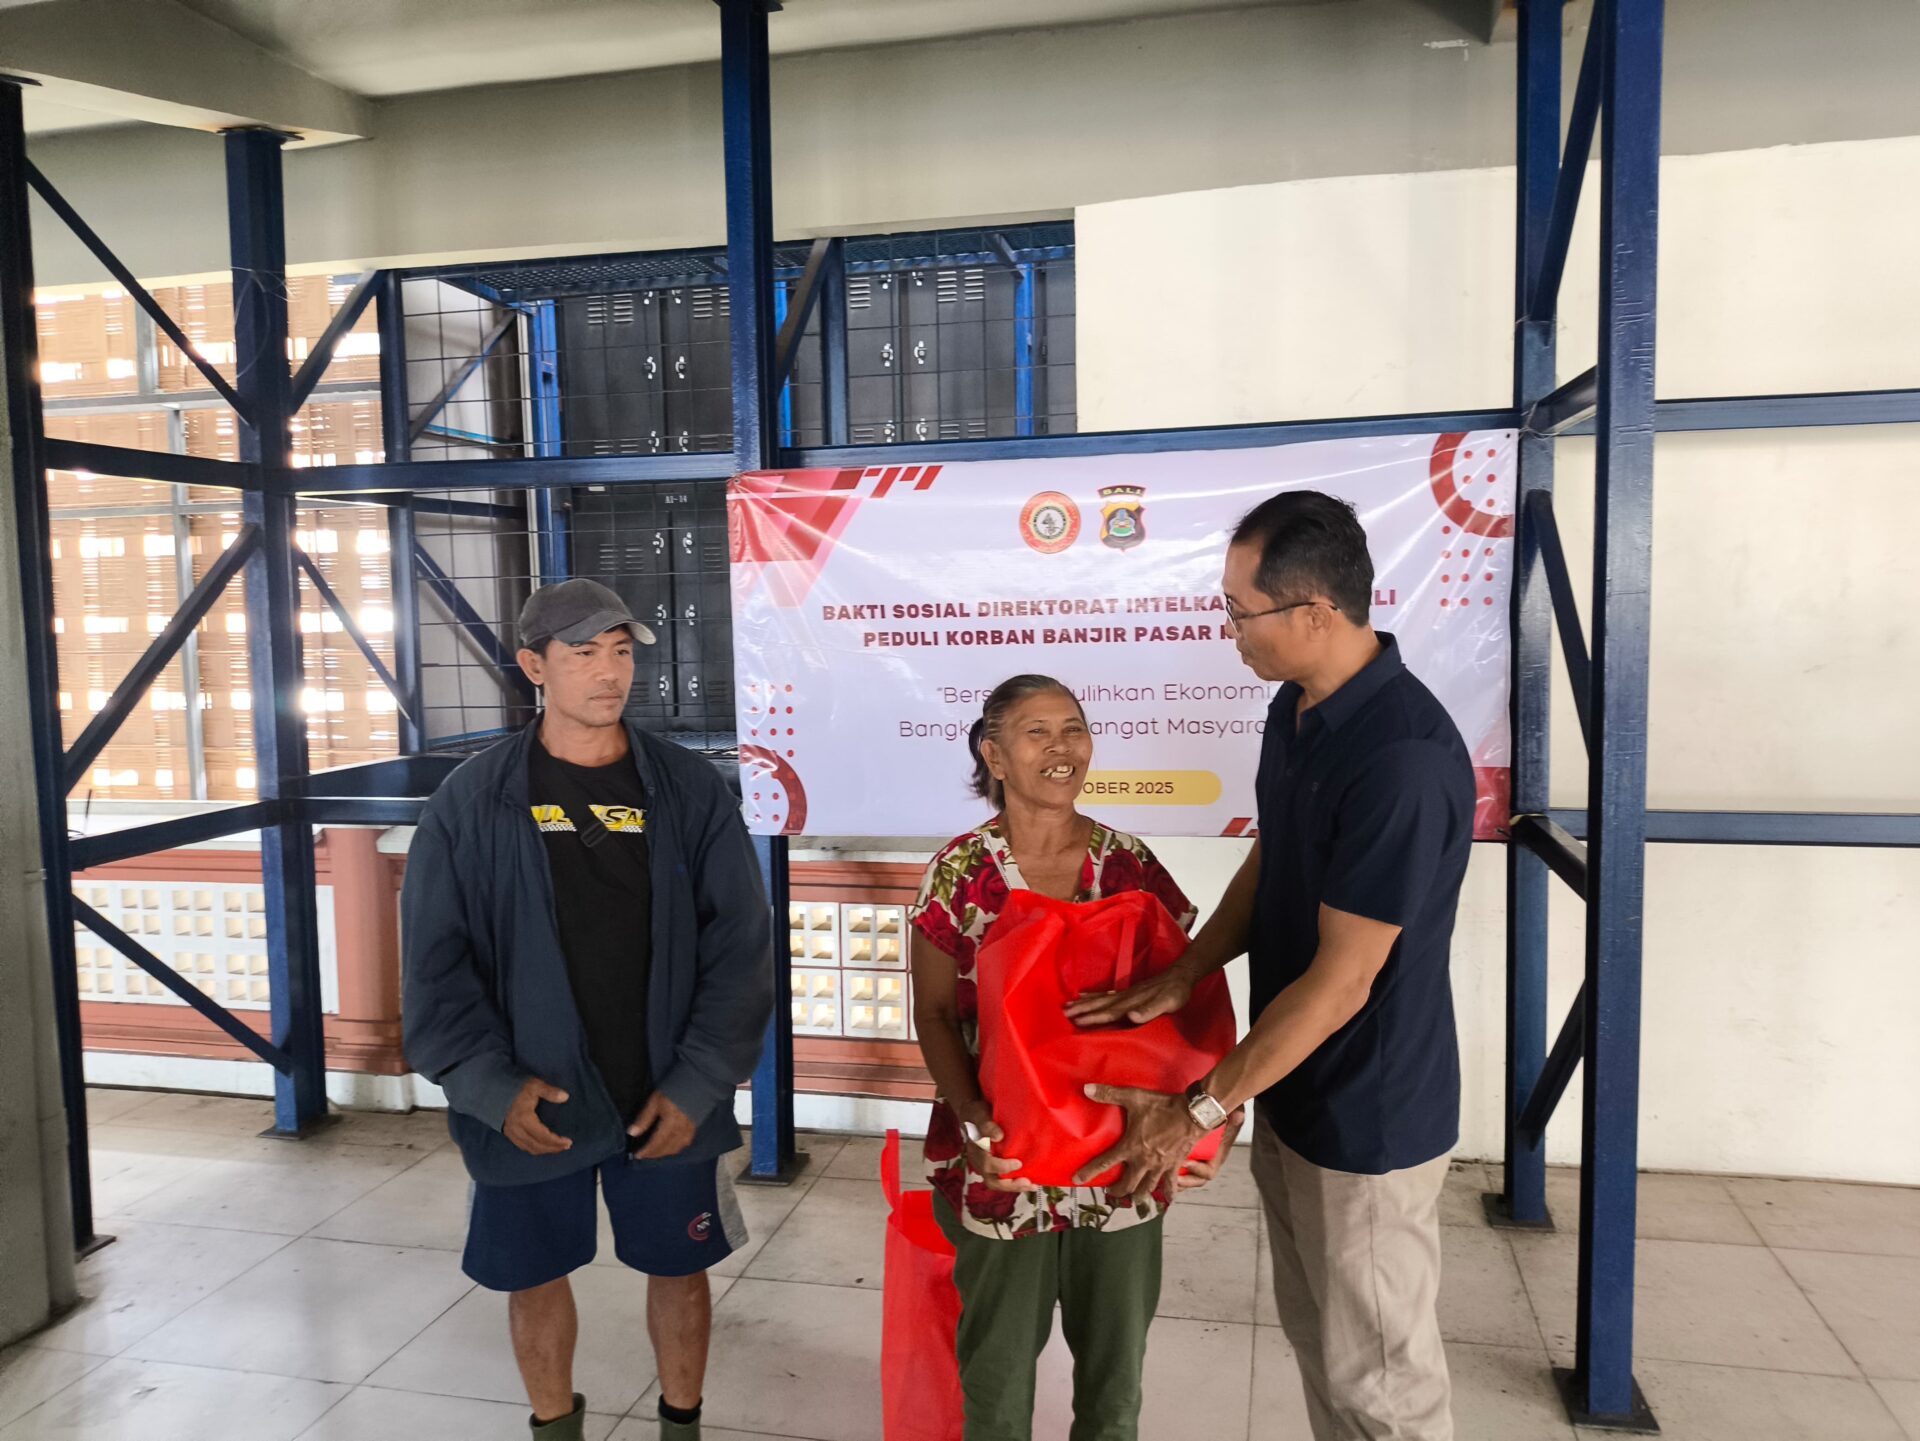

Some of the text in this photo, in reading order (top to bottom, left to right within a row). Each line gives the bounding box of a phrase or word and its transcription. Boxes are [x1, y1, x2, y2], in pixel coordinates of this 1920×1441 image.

[1102, 486, 1143, 496] BALI
[823, 604, 886, 621] BAKTI
[893, 602, 971, 619] SOSIAL
[977, 598, 1119, 617] DIREKTORAT
[1126, 595, 1225, 613] INTELKA
[864, 631, 939, 647] PEDULI
[947, 629, 1035, 646] KORBAN
[1043, 627, 1127, 644] BANJIR
[1135, 625, 1212, 642] PASAR
[1072, 684, 1155, 702] ulihkan
[1090, 717, 1159, 740] angat
[1167, 718, 1266, 739] Masyara
[1082, 781, 1175, 795] OBER 2025
